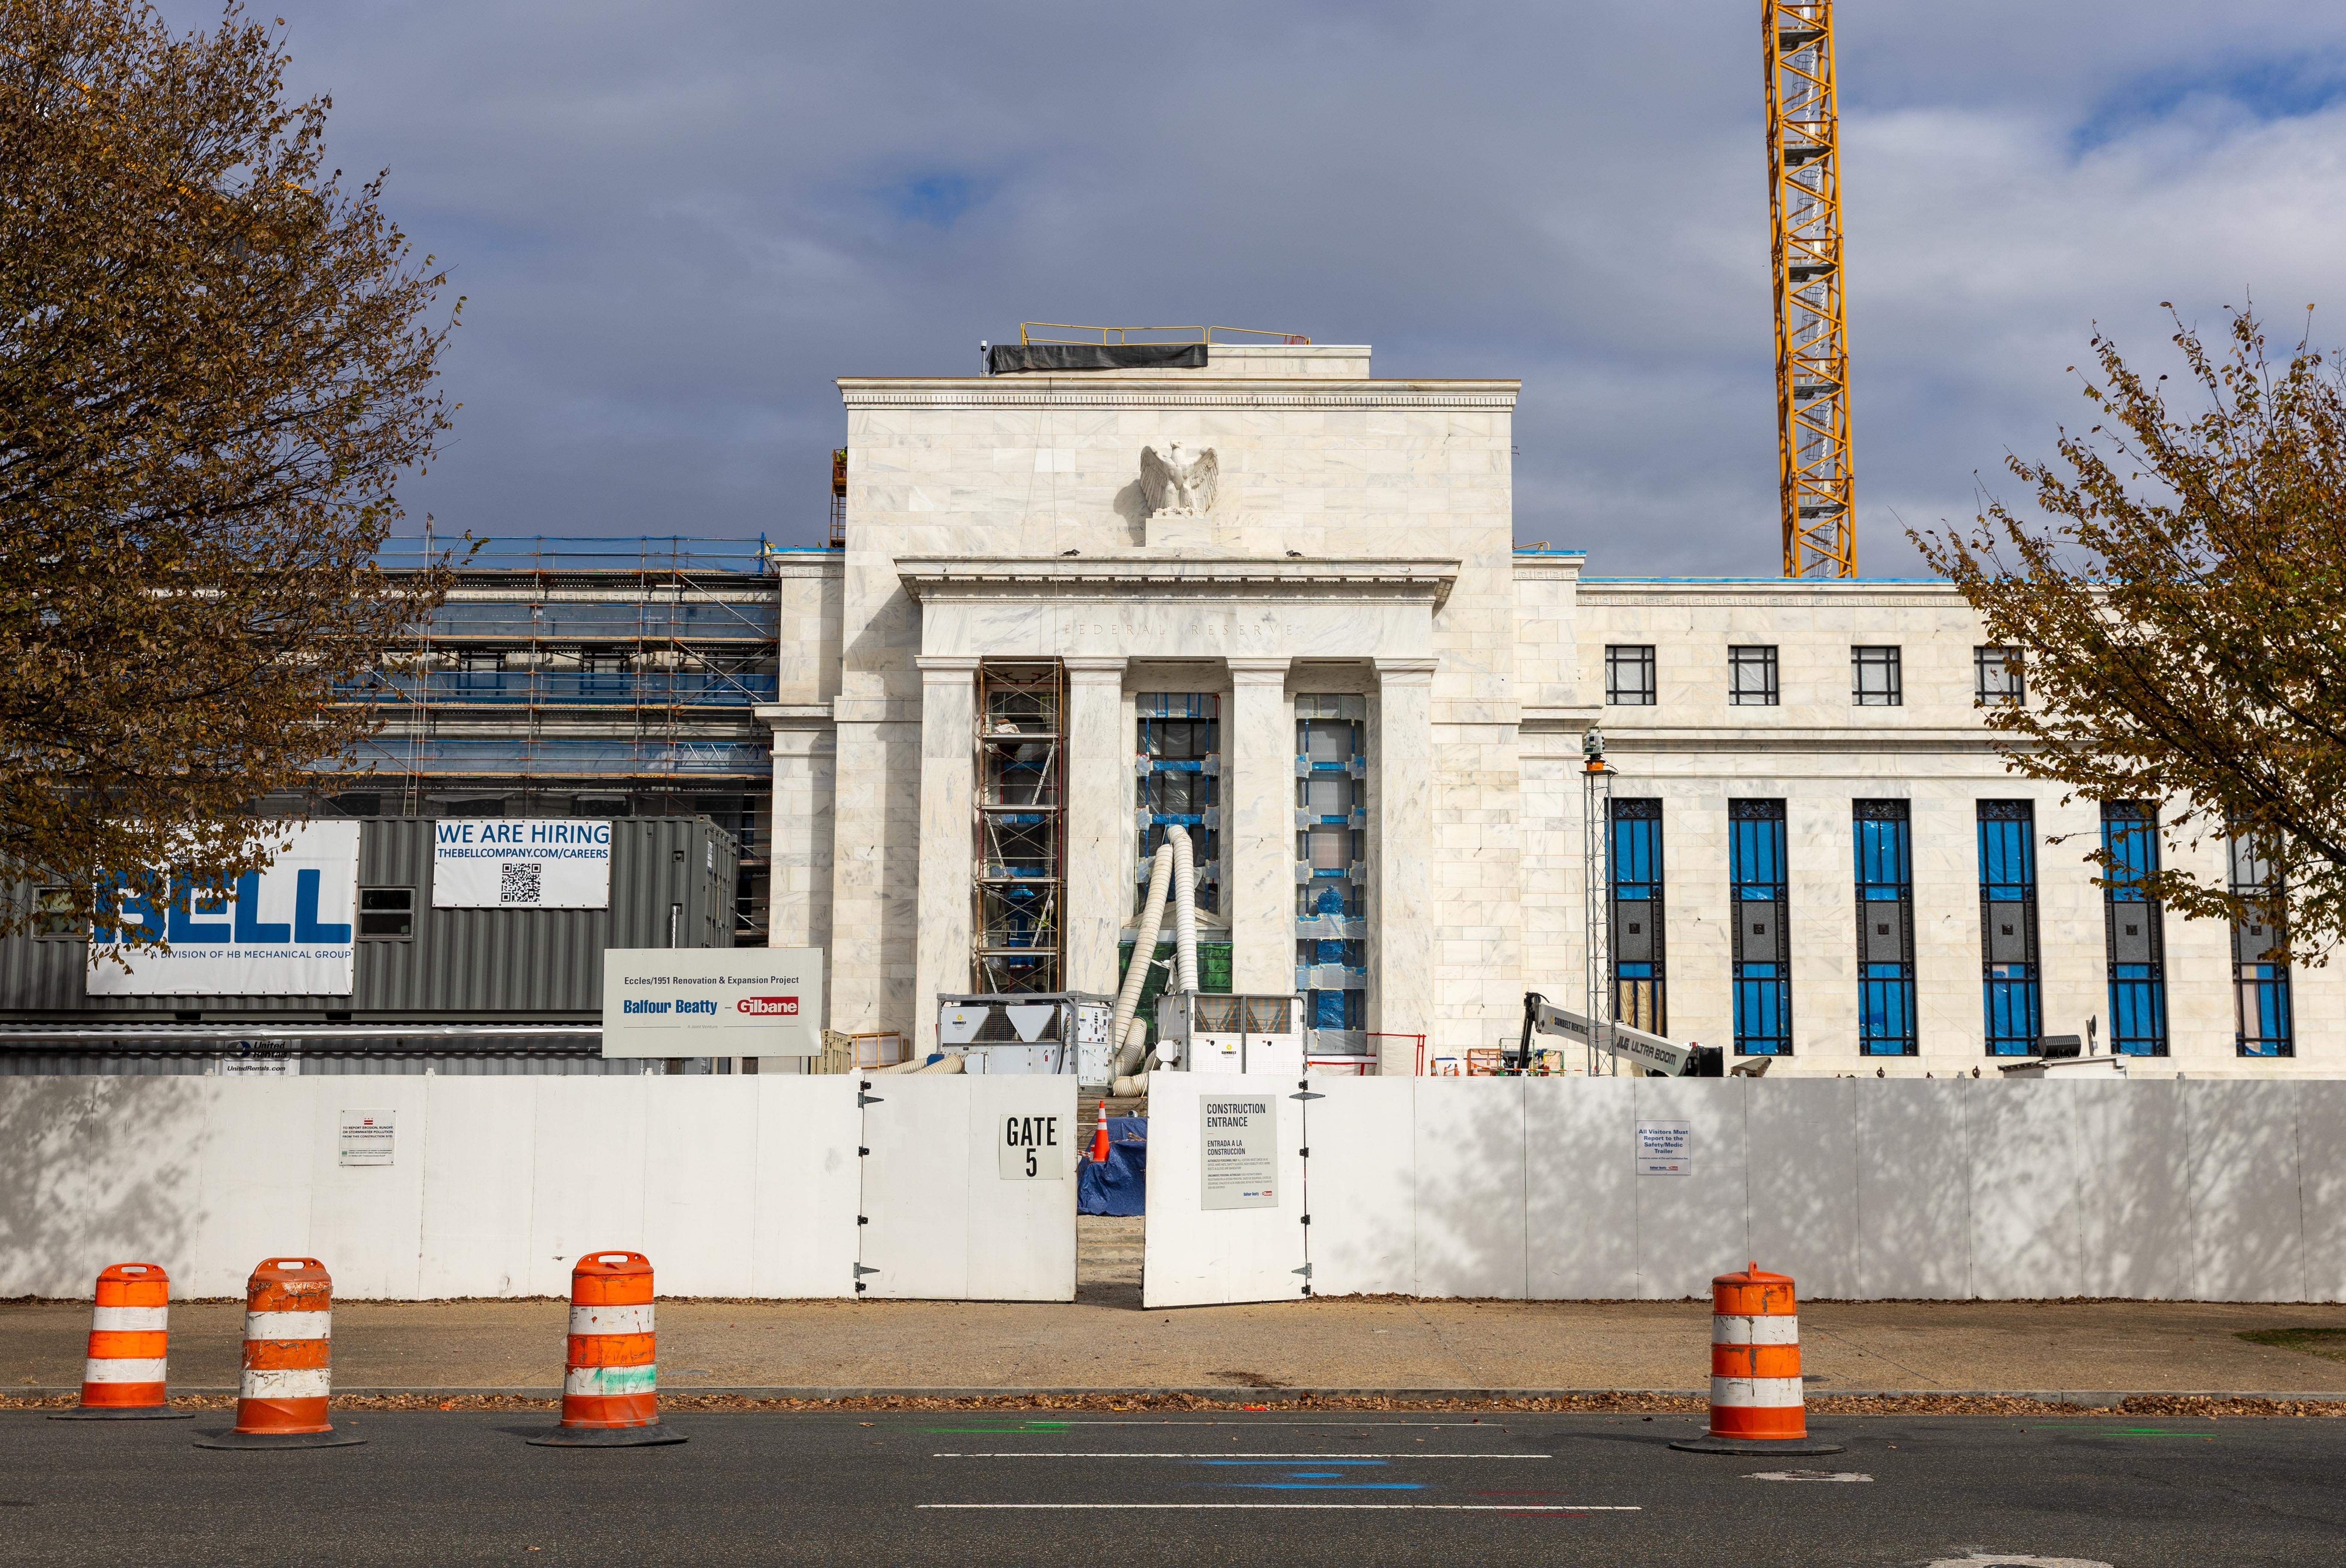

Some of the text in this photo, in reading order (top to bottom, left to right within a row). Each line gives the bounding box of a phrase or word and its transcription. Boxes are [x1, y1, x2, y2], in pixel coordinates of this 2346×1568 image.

[1065, 624, 1292, 635] FEDERAL RESERVE
[438, 825, 609, 844] WE ARE HIRING
[438, 848, 608, 859] THEBELLCOMPANY.COM/CAREERS
[94, 868, 352, 944] BELL
[624, 977, 670, 985] Eccles/1951
[728, 976, 768, 986] Expansion
[771, 976, 799, 985] Project
[624, 1000, 672, 1013] Balfour
[676, 1000, 718, 1015] Beatty
[737, 999, 798, 1014] Gilbane
[1554, 1017, 1588, 1036] SUNBELT RENTALS
[1616, 1036, 1677, 1066] JLG ULTRA BOOM
[1207, 1104, 1266, 1114] CONSTRUCTION
[1207, 1117, 1248, 1127] ENTRANCE
[1007, 1117, 1057, 1146] GATE
[1207, 1146, 1245, 1155] CONSTRUCCIÓN
[1026, 1148, 1037, 1177] 5
